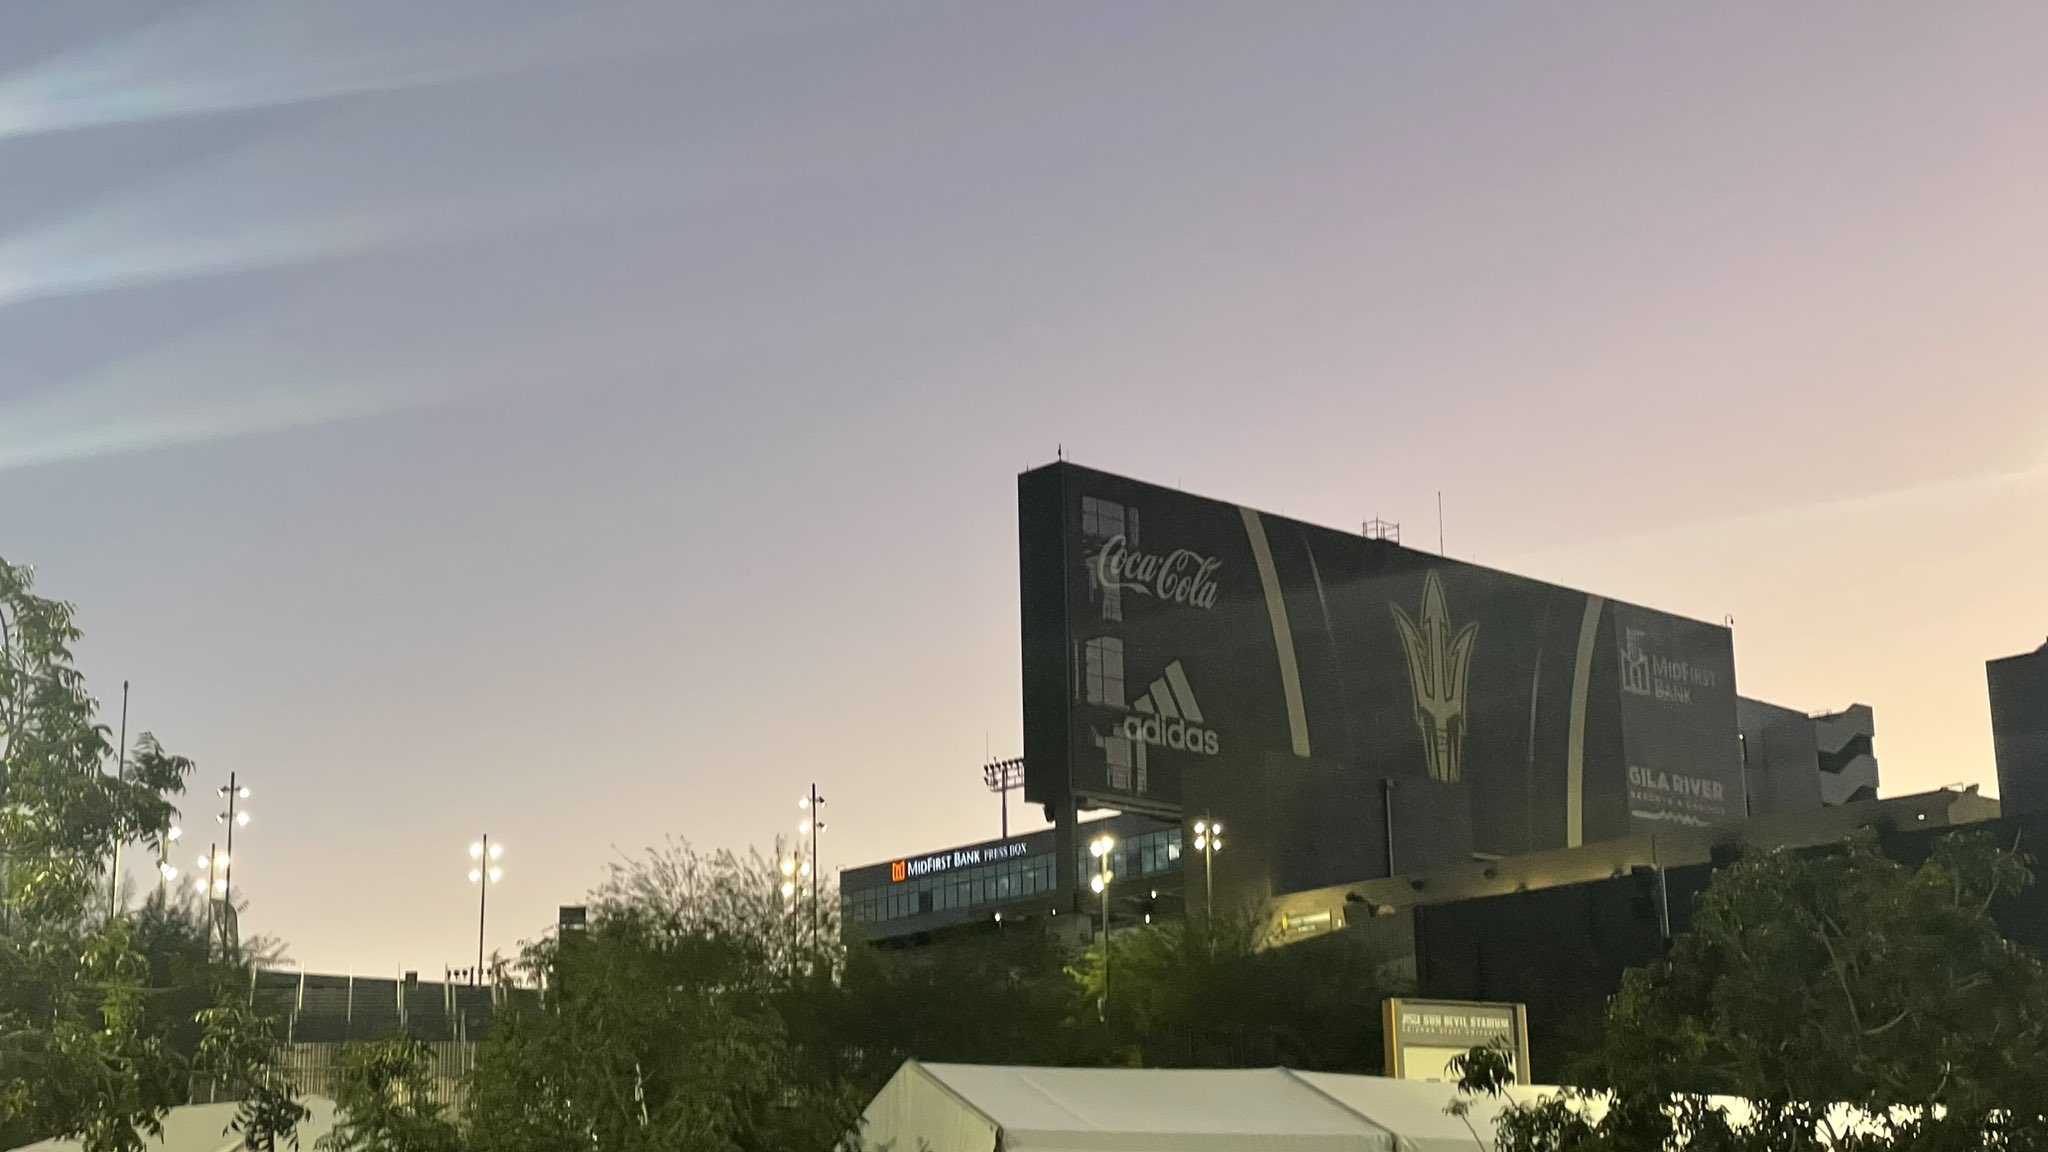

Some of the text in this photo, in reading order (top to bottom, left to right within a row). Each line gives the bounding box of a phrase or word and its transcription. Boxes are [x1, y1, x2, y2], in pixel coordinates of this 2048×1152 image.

[1097, 534, 1222, 610] Coca-Cola
[1123, 713, 1220, 755] adidas
[1629, 765, 1724, 801] GILA RIVER
[953, 851, 980, 868] BANK
[983, 846, 1008, 863] PRESS
[1009, 842, 1027, 857] BOX
[1423, 1014, 1441, 1026] SUN
[1443, 1015, 1466, 1028] DEVIL
[1470, 1016, 1509, 1029] STADIUM
